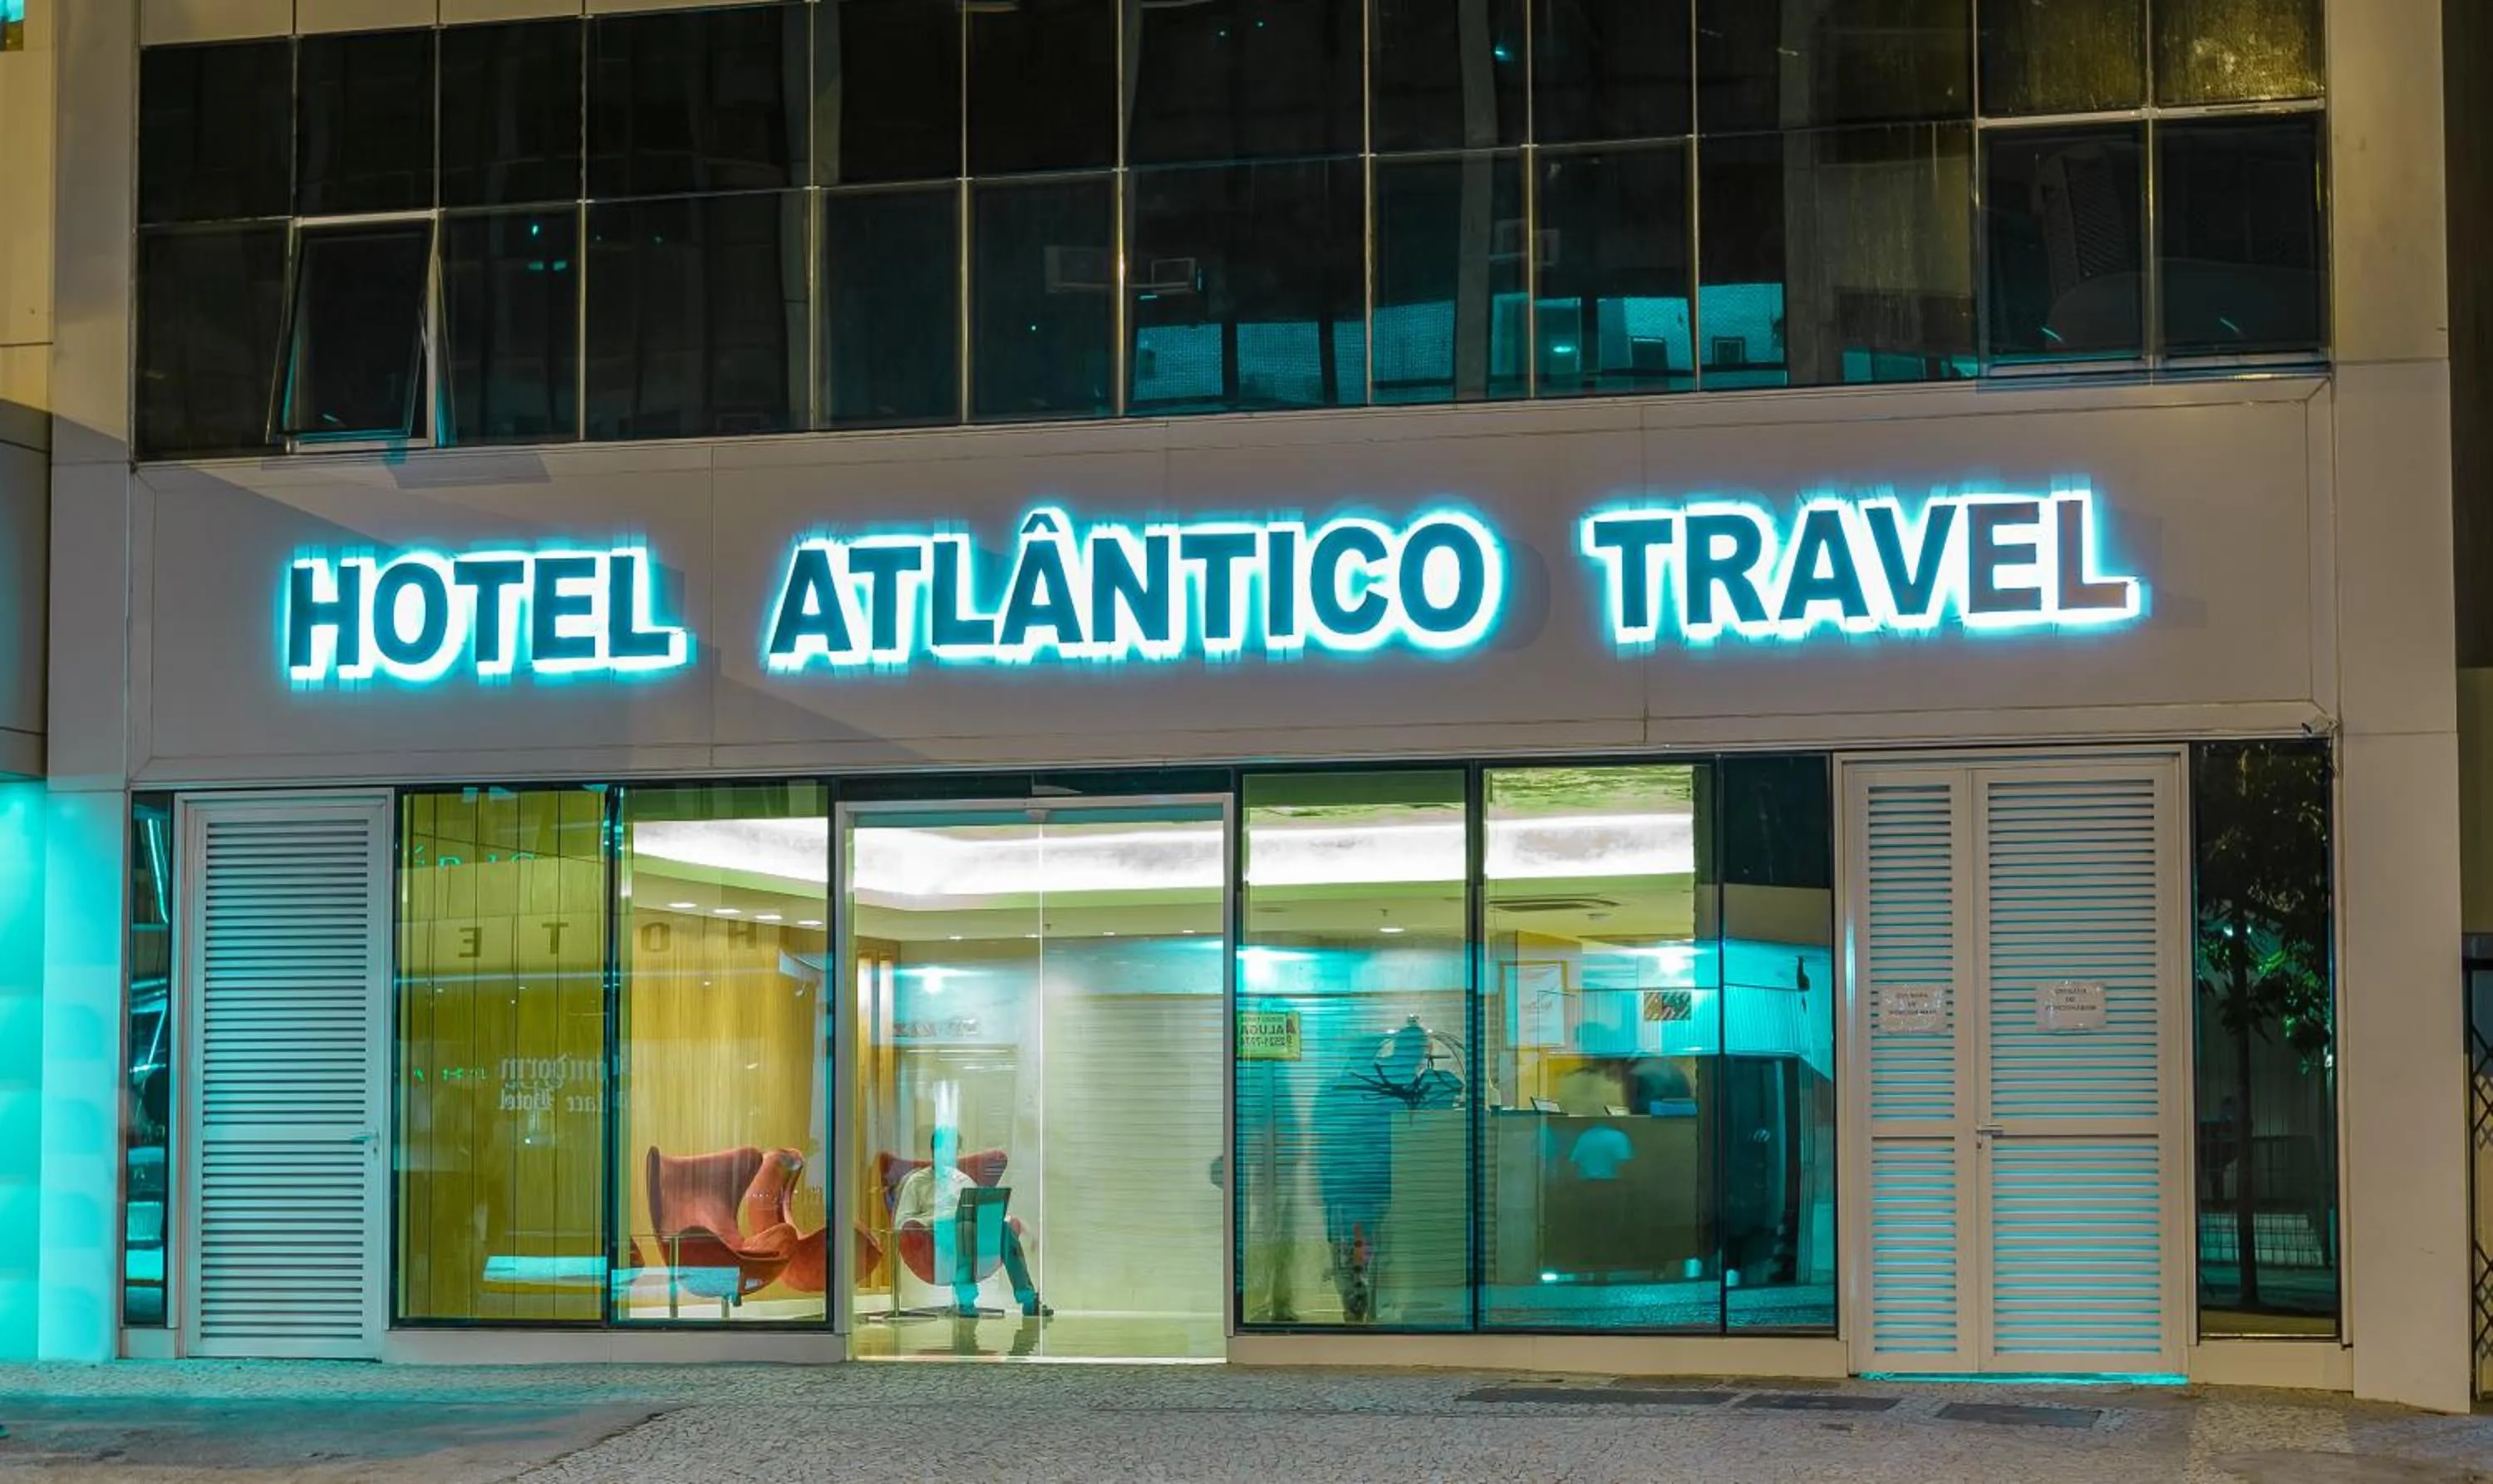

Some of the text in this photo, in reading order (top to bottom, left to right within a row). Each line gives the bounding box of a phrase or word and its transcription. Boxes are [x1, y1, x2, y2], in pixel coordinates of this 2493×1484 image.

[287, 494, 2134, 675] HOTEL ATLÂNTICO TRAVEL
